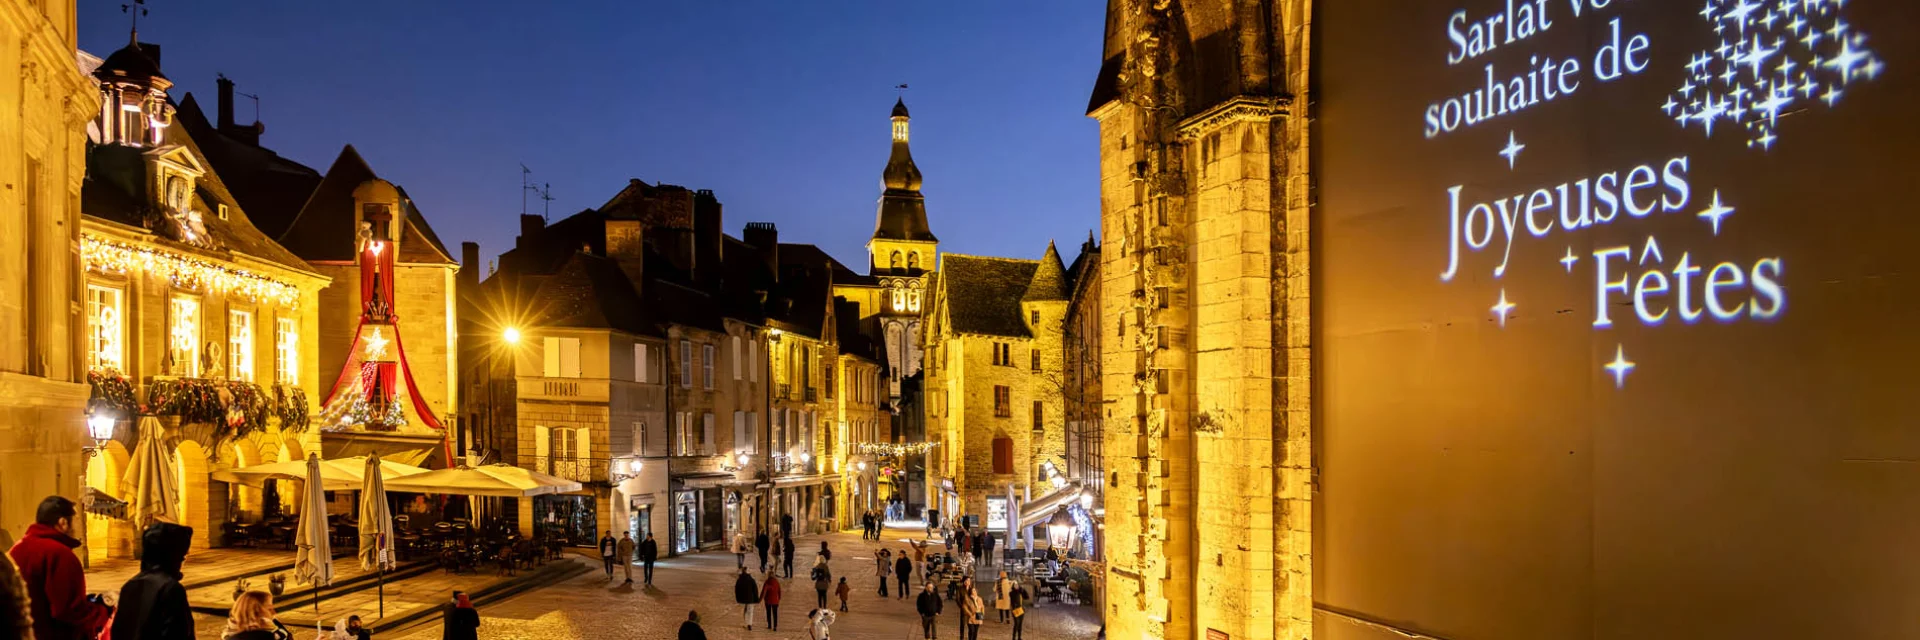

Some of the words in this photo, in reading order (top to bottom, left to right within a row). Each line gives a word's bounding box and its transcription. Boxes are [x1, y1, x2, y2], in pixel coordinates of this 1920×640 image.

[1424, 55, 1580, 139] souhaite
[1594, 17, 1650, 81] de
[1447, 0, 1552, 65] Sarlat
[1440, 156, 1691, 282] Joyeuses
[1592, 236, 1786, 330] Fêtes
